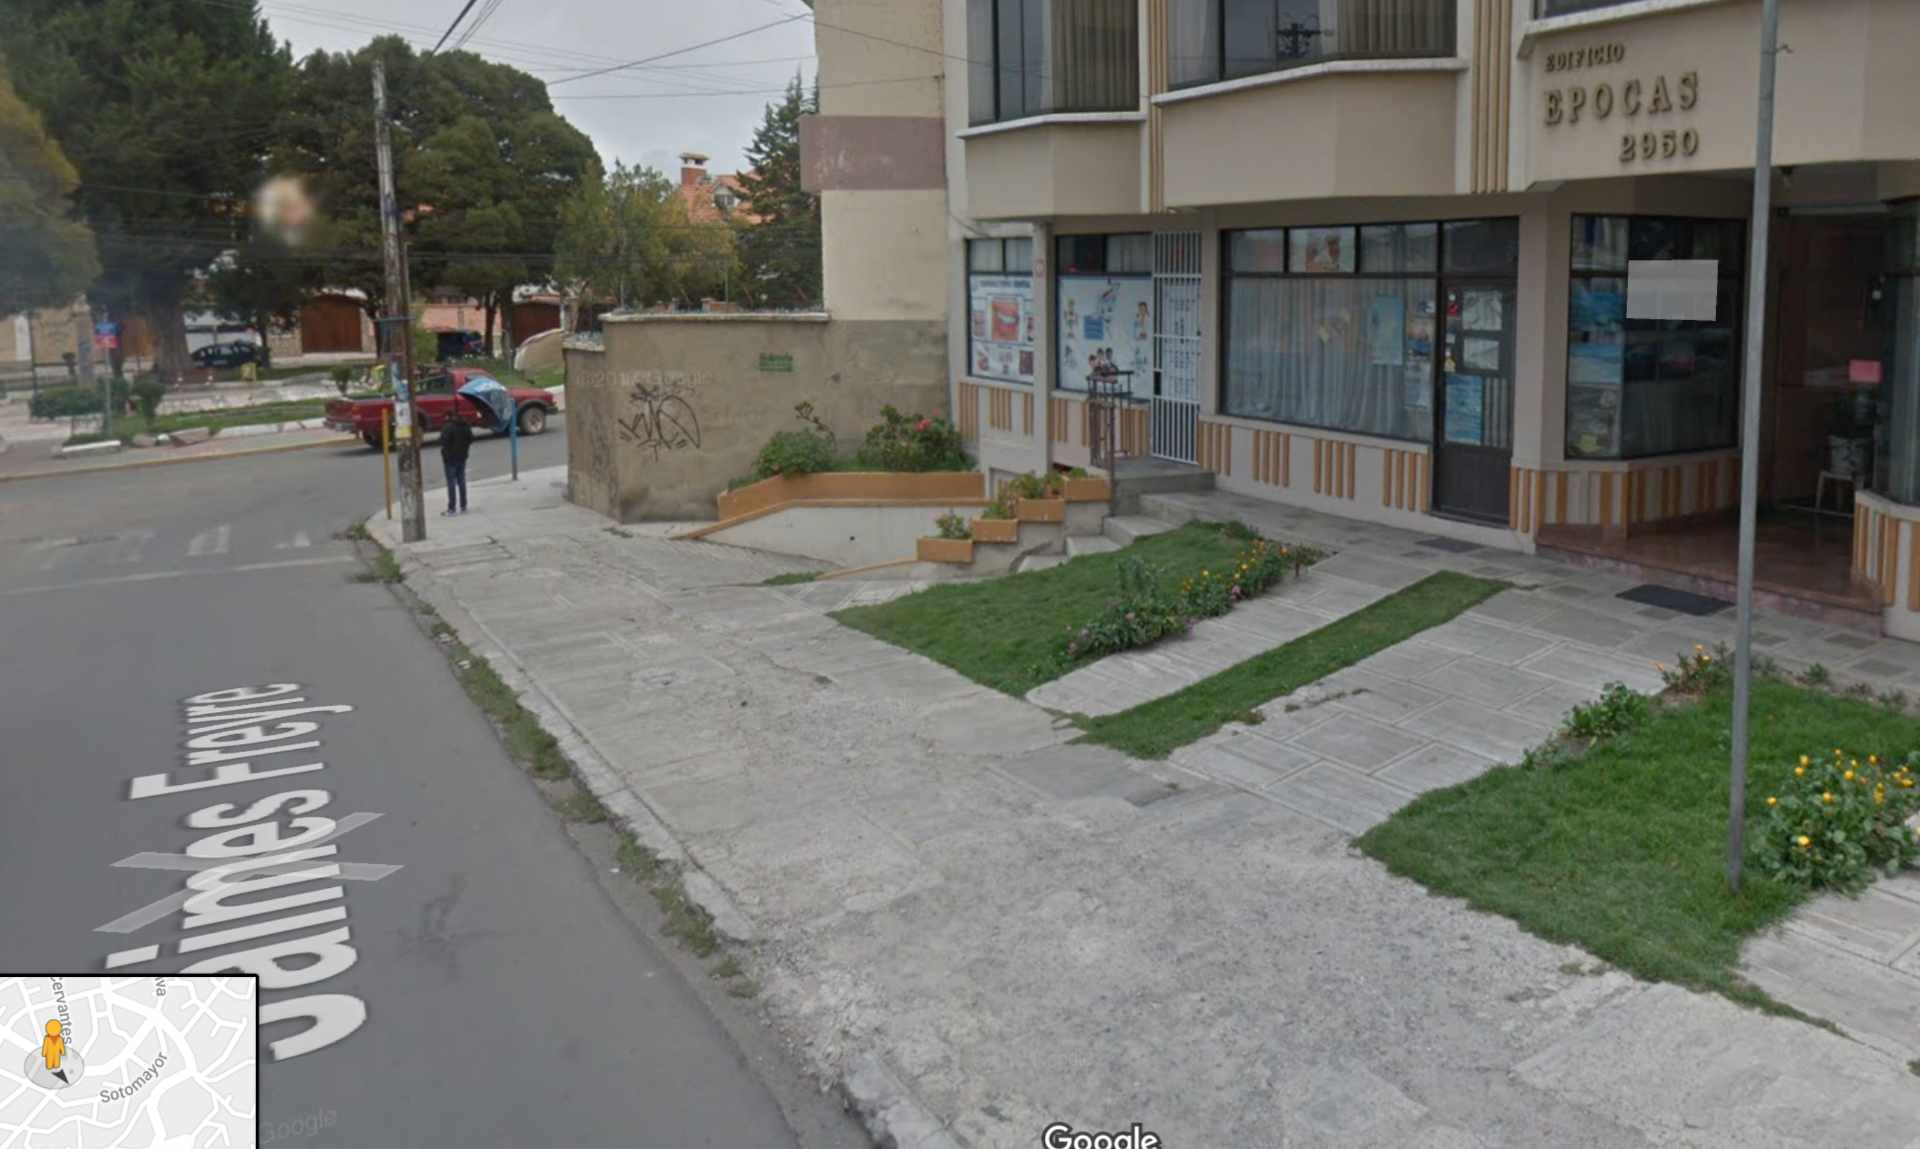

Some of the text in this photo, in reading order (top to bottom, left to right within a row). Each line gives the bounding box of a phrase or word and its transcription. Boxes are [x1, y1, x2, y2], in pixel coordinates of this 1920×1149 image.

[1544, 42, 1625, 72] EDIFICIO
[1544, 71, 1698, 126] EPOCAS
[1618, 128, 1700, 164] 2950
